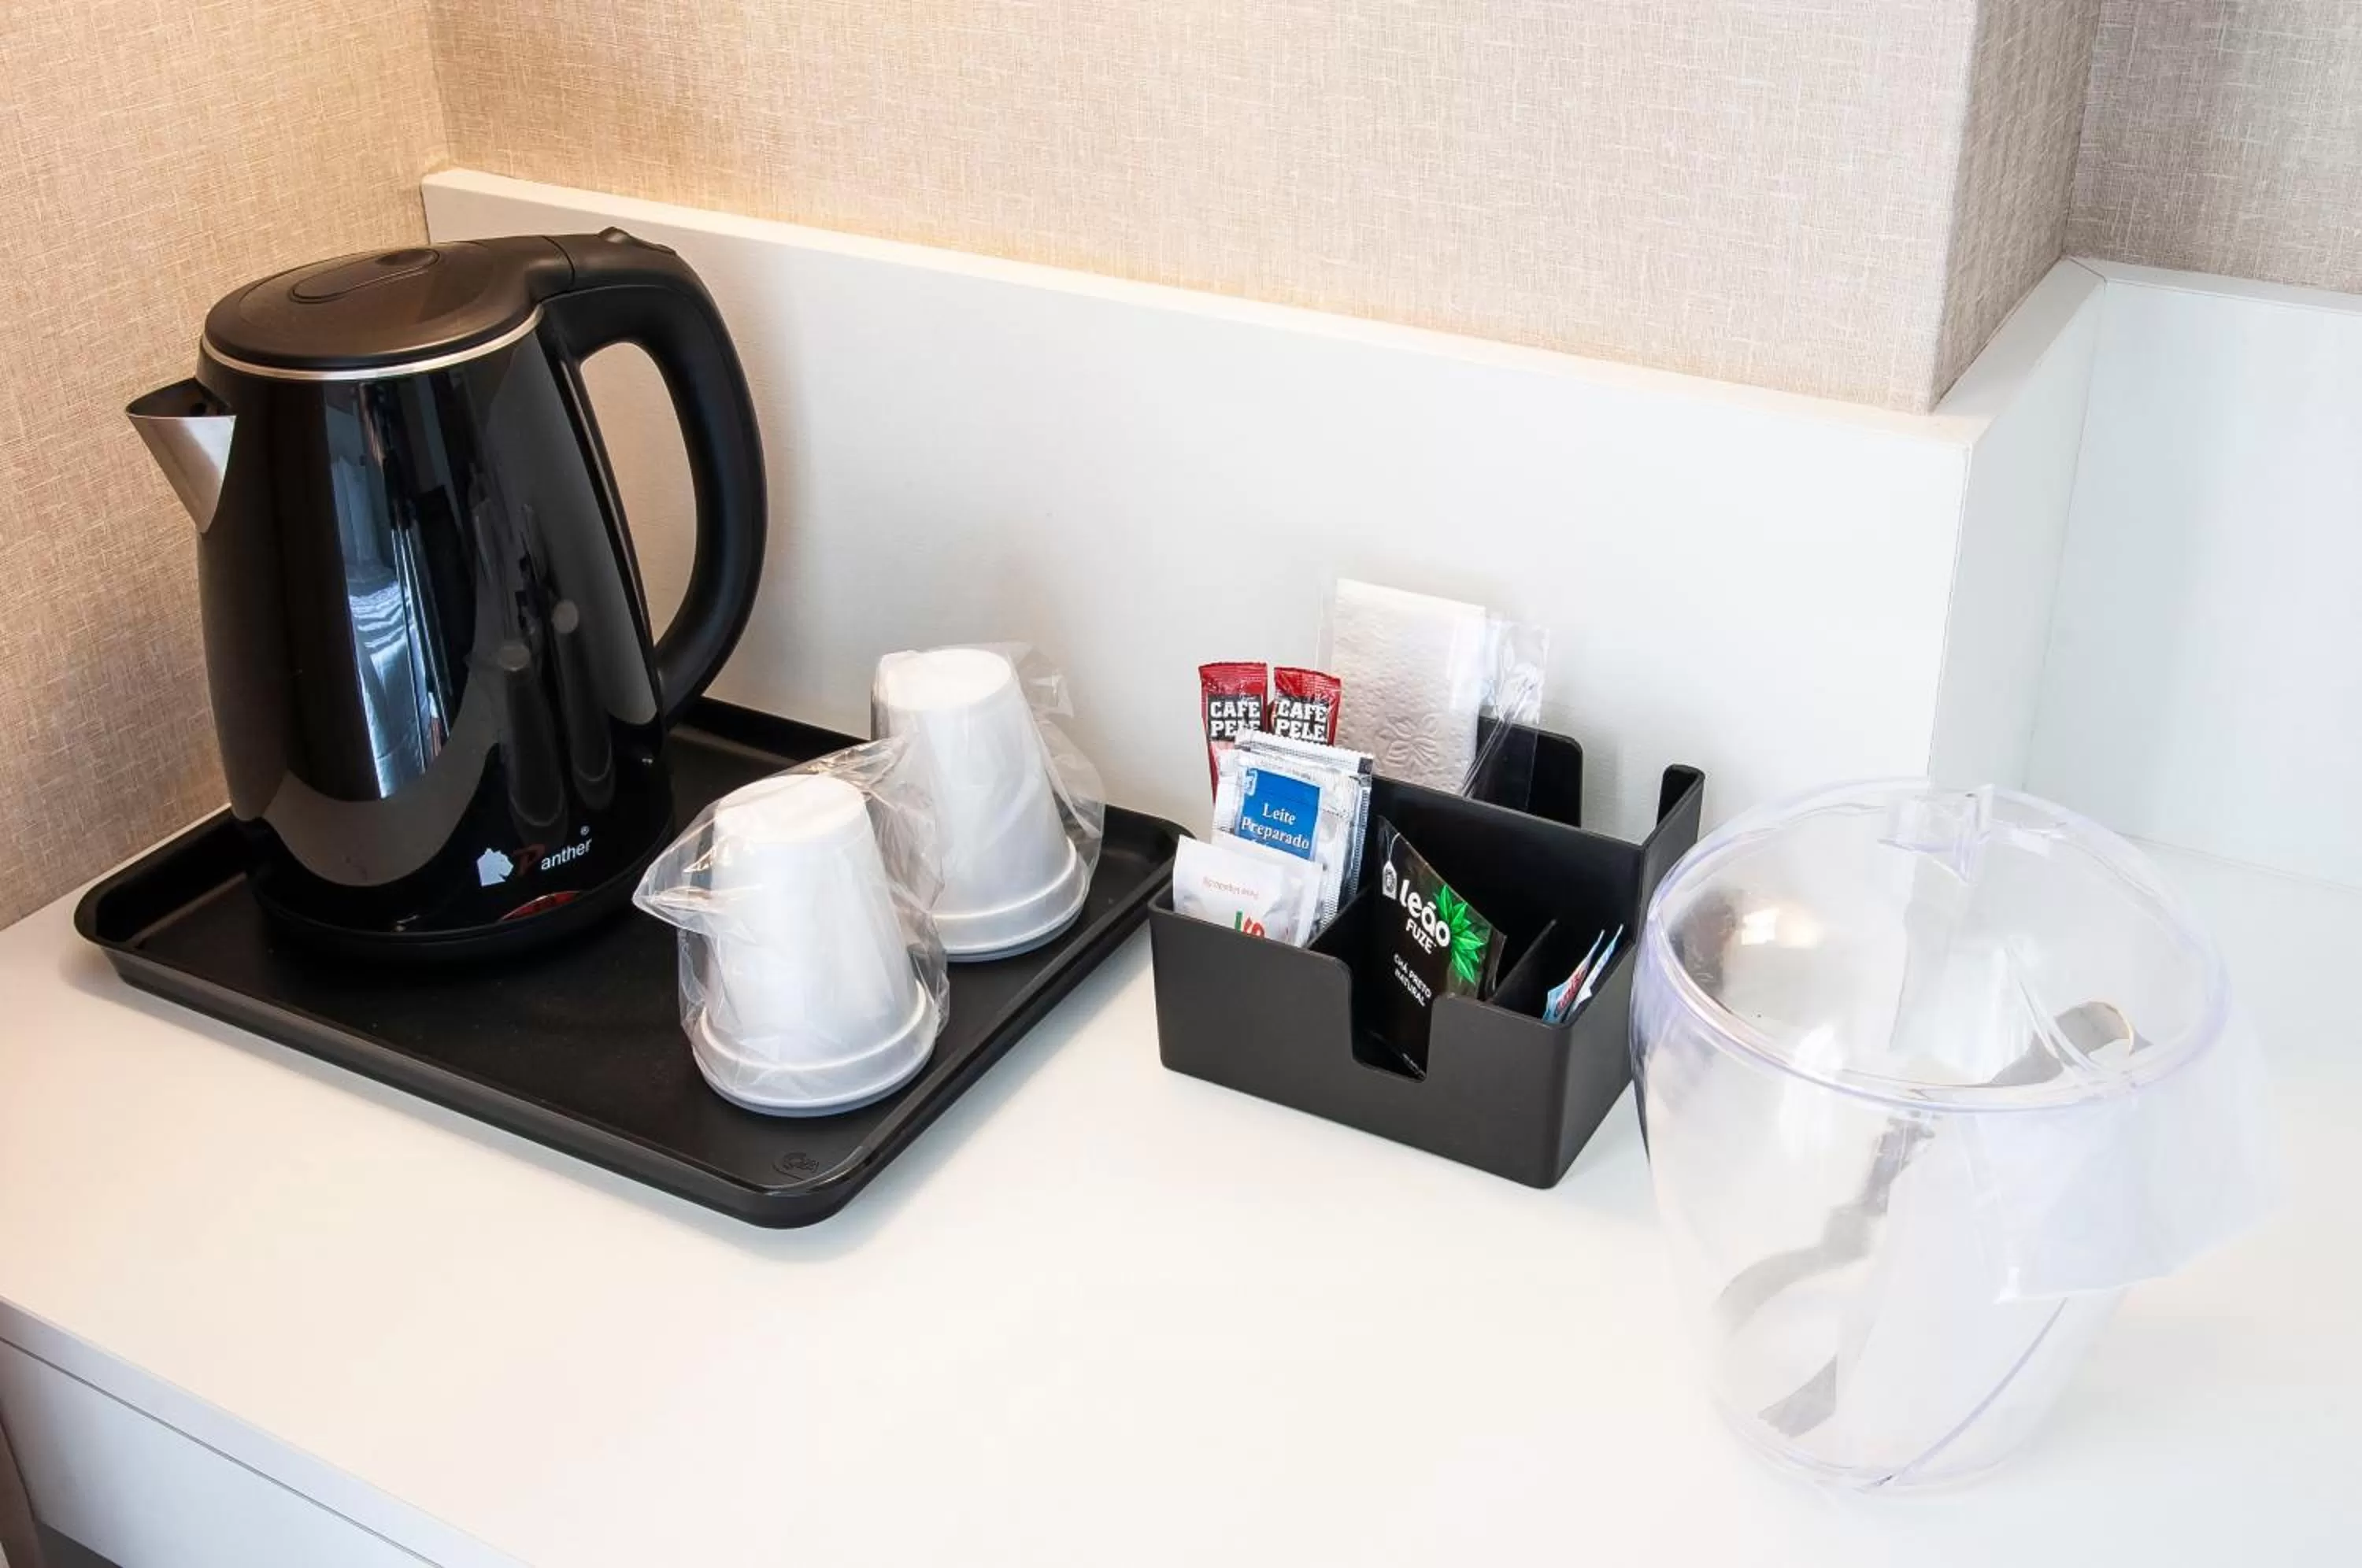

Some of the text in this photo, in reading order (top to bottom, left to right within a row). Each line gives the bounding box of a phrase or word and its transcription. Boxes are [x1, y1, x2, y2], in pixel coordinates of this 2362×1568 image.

[1262, 802, 1297, 826] Leite
[1241, 815, 1310, 850] Preparado
[1405, 918, 1434, 955] FUZE
[1394, 967, 1427, 1008] NATURAL
